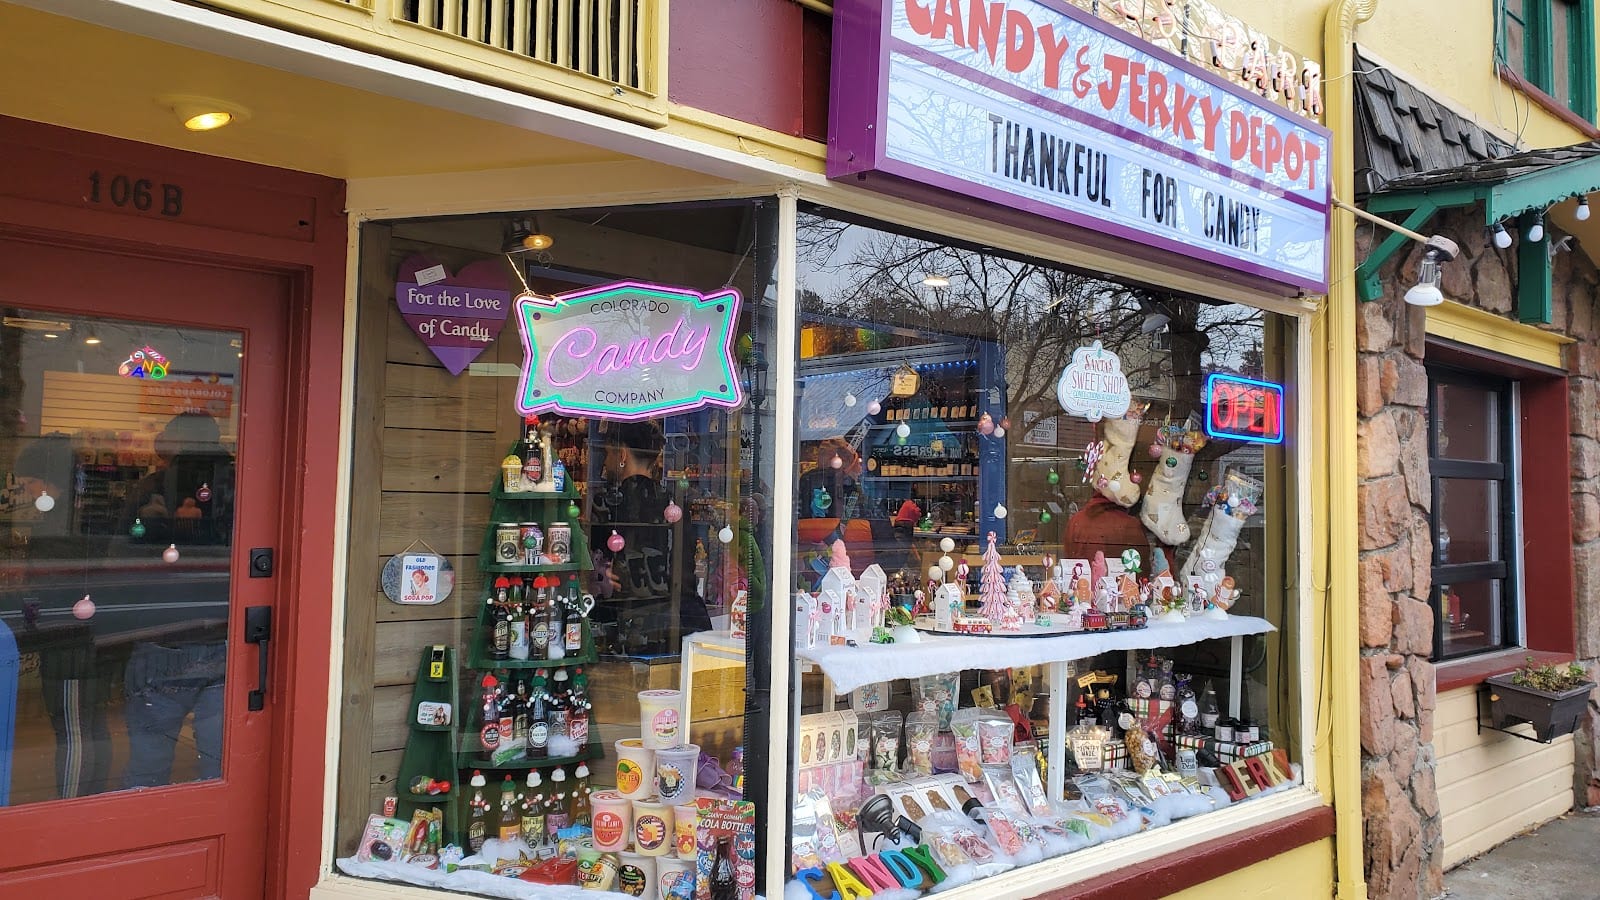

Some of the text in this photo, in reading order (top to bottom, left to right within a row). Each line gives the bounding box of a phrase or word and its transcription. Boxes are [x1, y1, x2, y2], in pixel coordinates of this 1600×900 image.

[904, 0, 1068, 89] CANDY
[1072, 45, 1091, 100] &
[1098, 53, 1223, 152] JERKY
[1230, 110, 1320, 191] DEPOT
[87, 169, 183, 217] 106 B
[988, 113, 1261, 253] THANKFUL FOR CANDY
[407, 288, 502, 311] For the Love
[590, 299, 669, 315] COLORADO
[419, 319, 495, 342] of Candy
[545, 318, 710, 388] Candy
[594, 388, 665, 405] COMPANY
[1072, 370, 1125, 394] SWEET SHOP
[1212, 384, 1280, 435] OPEN
[700, 818, 720, 829] COLA
[797, 844, 948, 900] CANDY
